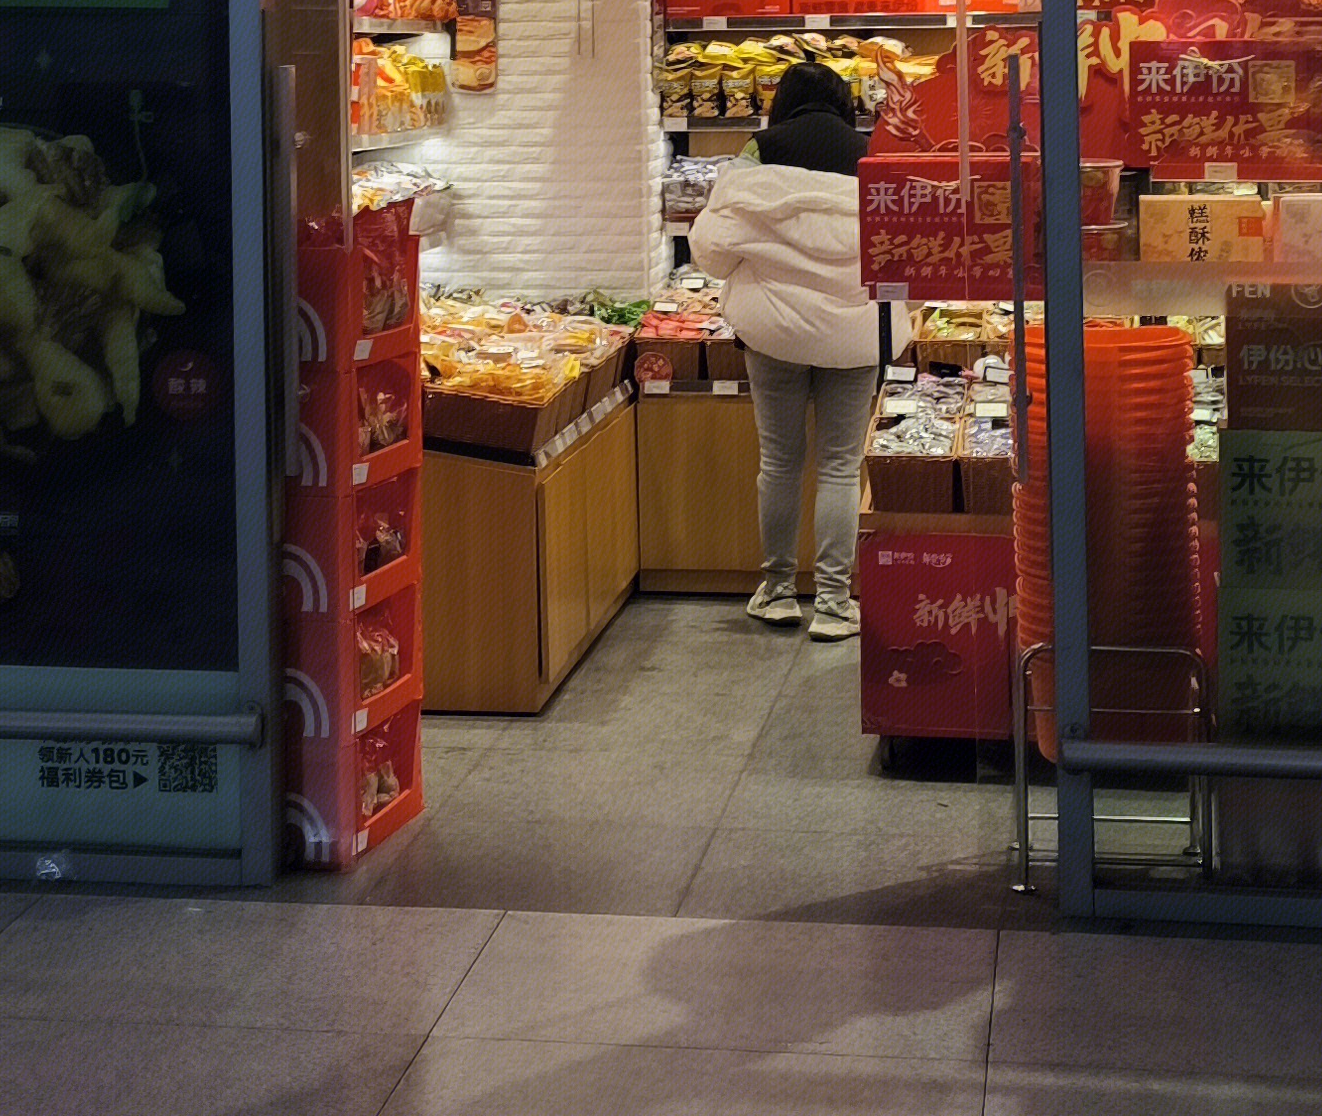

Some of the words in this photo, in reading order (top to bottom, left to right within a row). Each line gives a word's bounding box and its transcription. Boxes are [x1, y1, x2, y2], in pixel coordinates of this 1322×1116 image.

[1137, 59, 1244, 95] 来伊份
[866, 180, 966, 214] 来伊份
[868, 229, 1013, 272] 新鲜优果
[37, 746, 150, 767] 领新人180元
[38, 765, 129, 790] 福利券包
